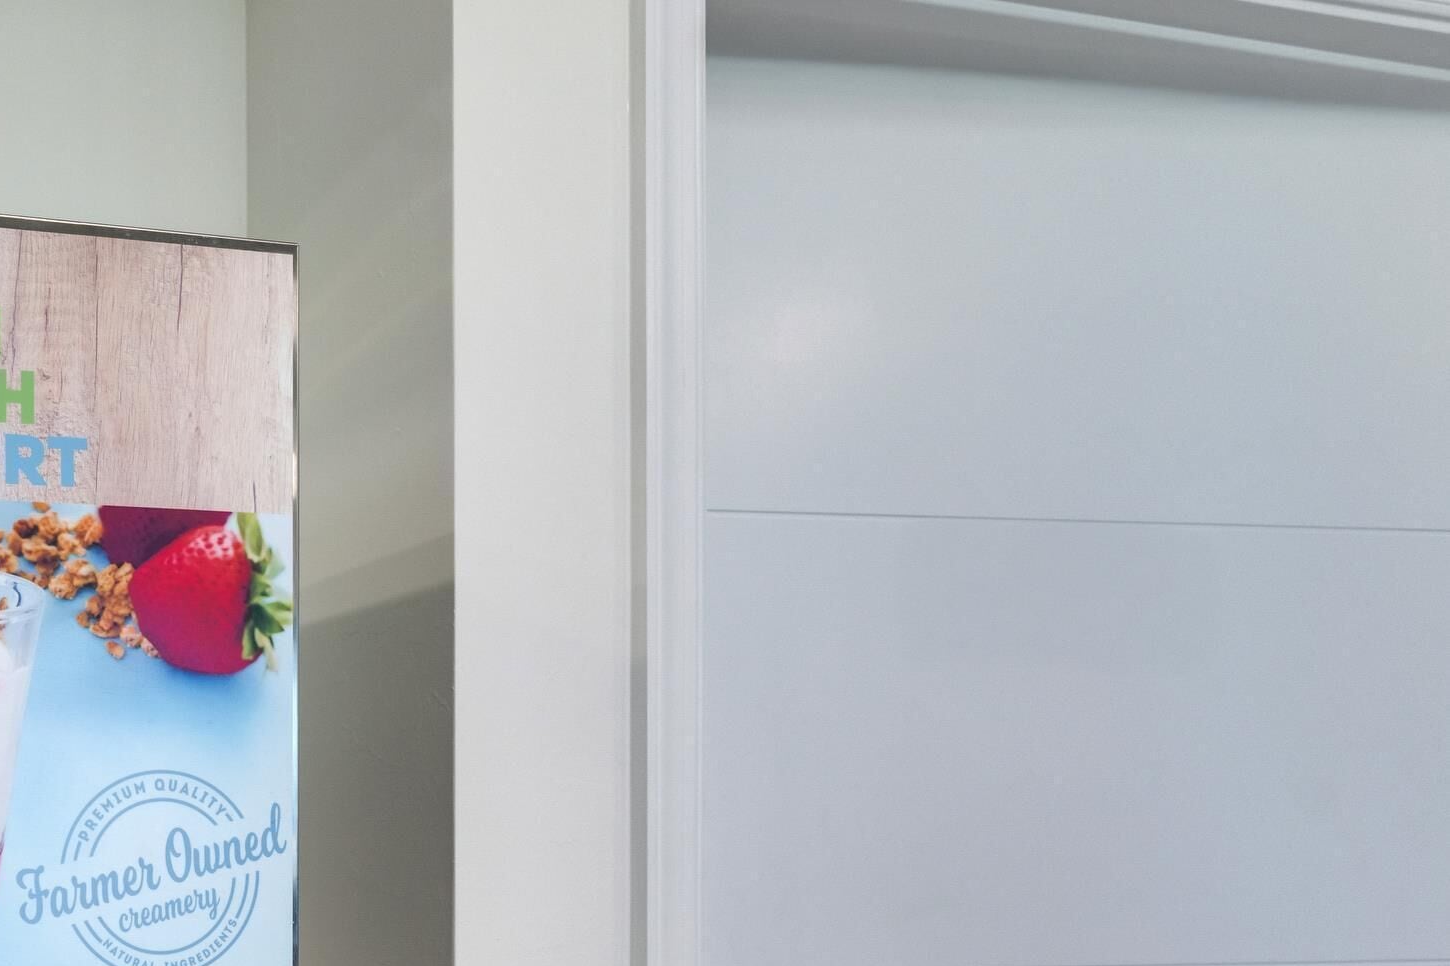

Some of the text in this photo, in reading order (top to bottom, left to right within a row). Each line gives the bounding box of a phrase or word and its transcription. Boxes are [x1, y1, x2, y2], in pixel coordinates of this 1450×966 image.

[78, 778, 226, 842] PREMIUM QUALITY
[16, 802, 287, 924] Farmer Owned
[119, 888, 220, 932] creamery
